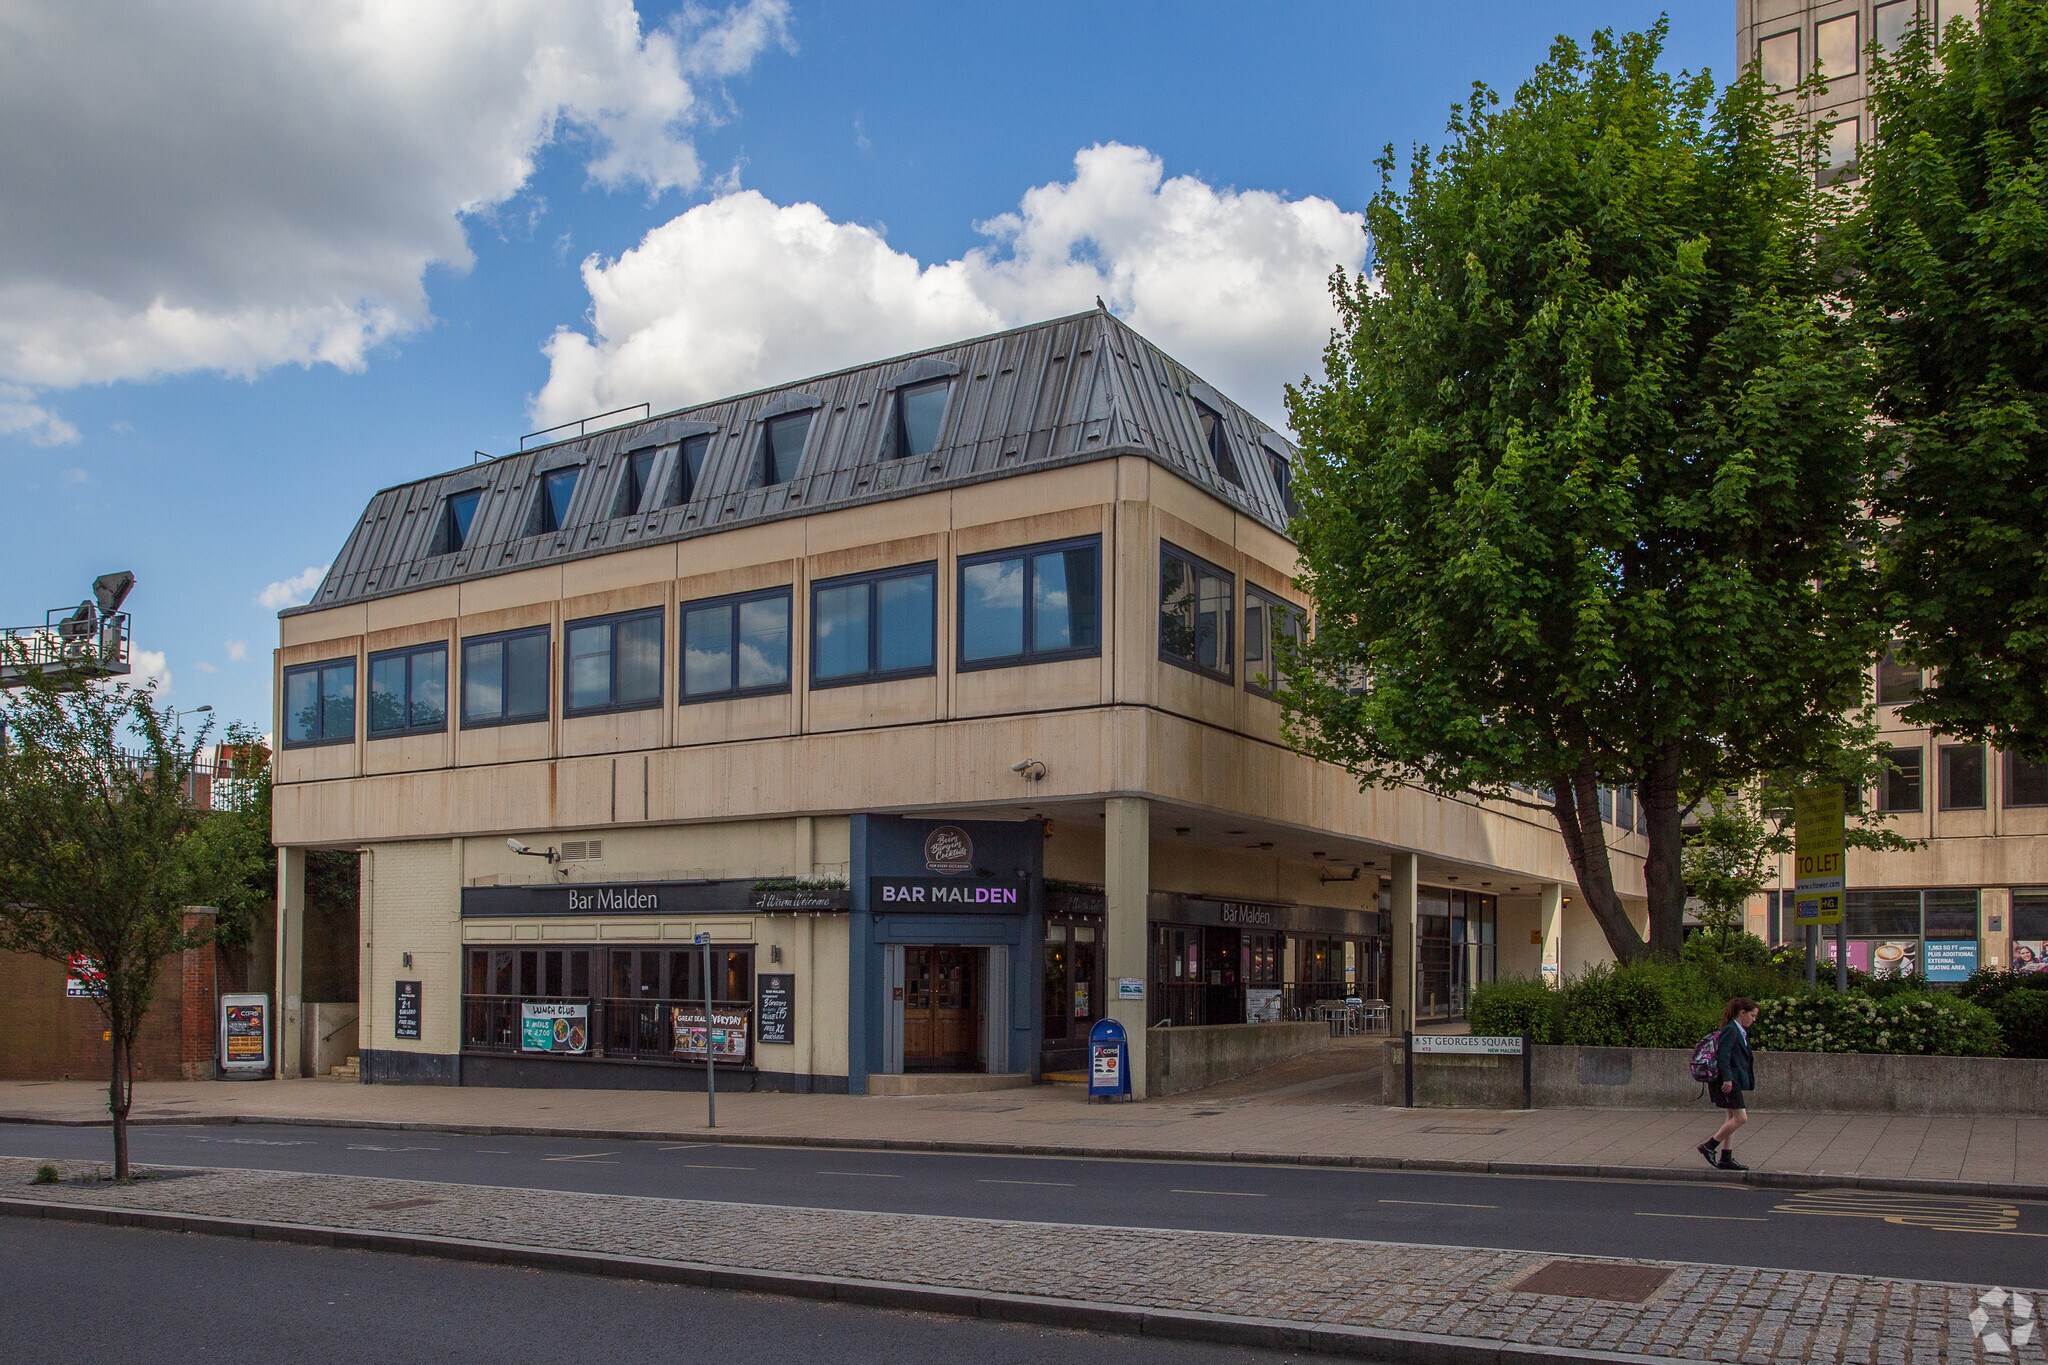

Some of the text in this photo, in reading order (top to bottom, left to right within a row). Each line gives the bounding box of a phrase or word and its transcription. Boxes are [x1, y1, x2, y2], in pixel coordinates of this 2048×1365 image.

[1818, 802, 1836, 813] SUITES
[937, 835, 958, 846] Beers
[931, 841, 962, 854] Burgers
[936, 847, 967, 860] Cocktails
[1798, 853, 1839, 874] TO LET
[569, 888, 658, 909] Bar Malden
[756, 892, 830, 908] A Warm Welcome
[882, 886, 1017, 903] BAR MALDEN
[1223, 903, 1270, 924] Bar Malden
[532, 1005, 576, 1016] LUNCH CLUB
[776, 1024, 785, 1033] XL
[1422, 1037, 1520, 1047] ST GEORGES SQUARE
